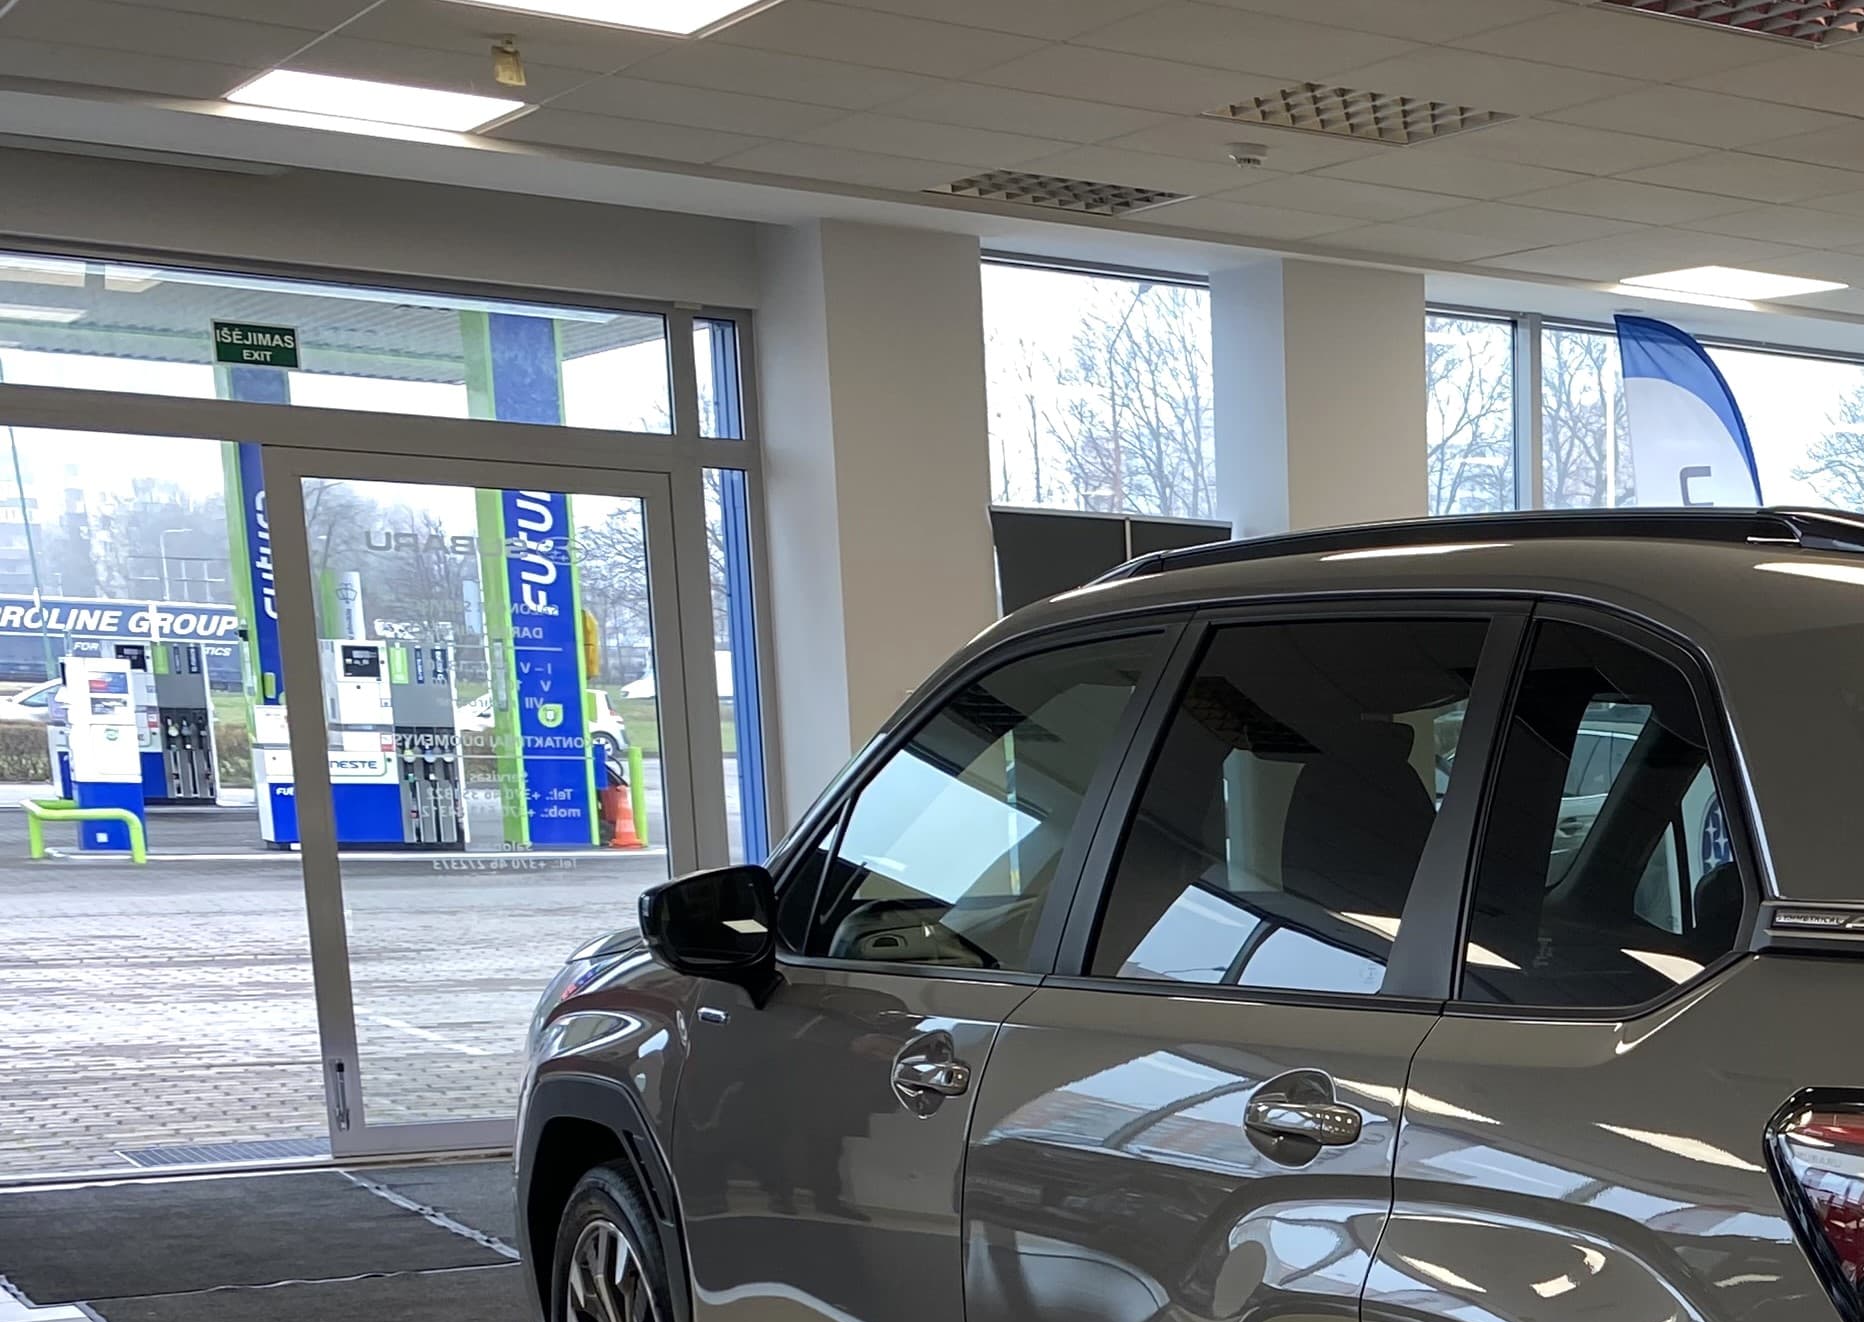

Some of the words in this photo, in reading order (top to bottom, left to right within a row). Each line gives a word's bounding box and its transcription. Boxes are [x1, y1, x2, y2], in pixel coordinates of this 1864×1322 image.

[216, 327, 294, 348] IŠĖJIMAS
[243, 349, 273, 362] EXIT
[0, 605, 122, 632] ROLINE
[128, 612, 239, 637] GROUP
[73, 641, 99, 651] FOR
